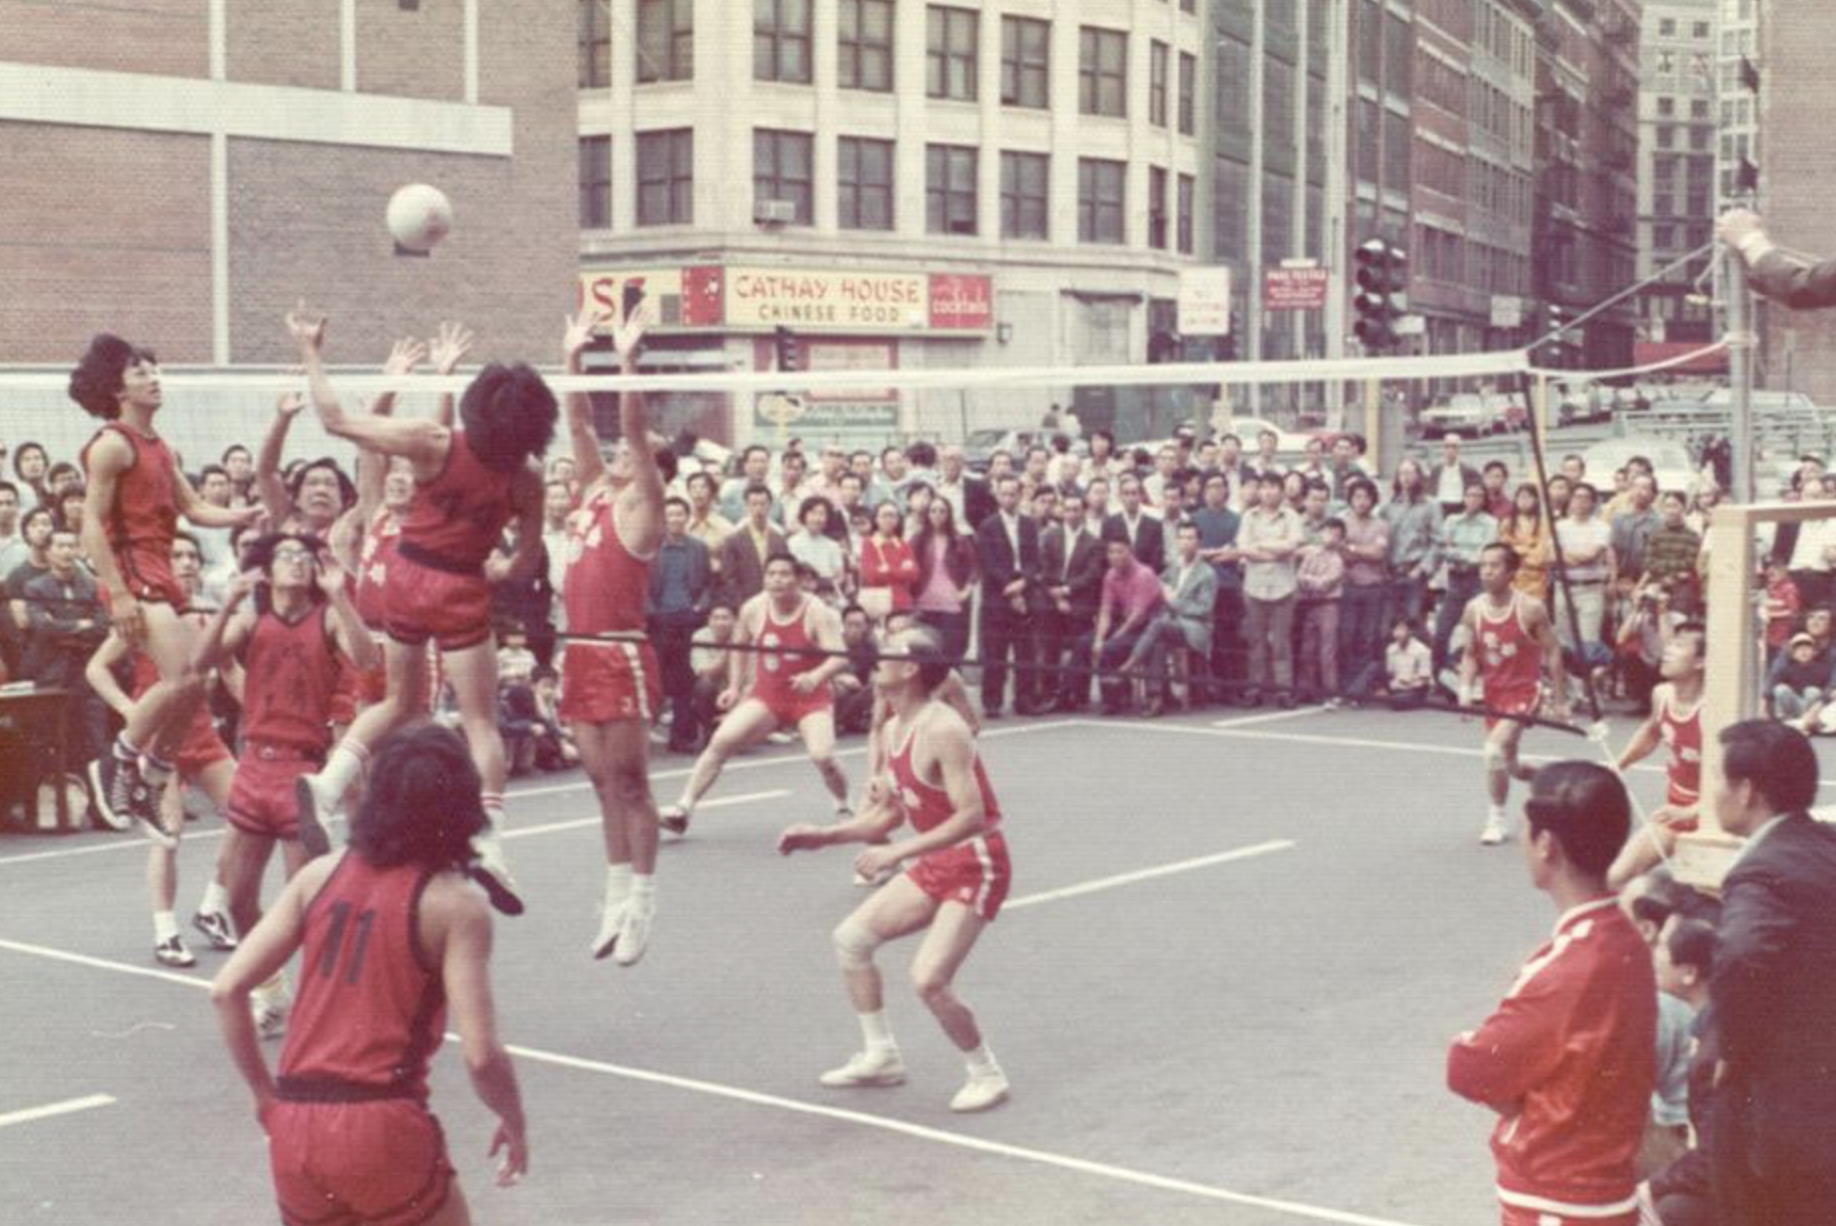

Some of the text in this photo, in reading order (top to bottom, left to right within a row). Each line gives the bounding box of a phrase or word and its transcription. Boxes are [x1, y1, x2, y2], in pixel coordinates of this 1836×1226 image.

[735, 274, 920, 304] CATHAY HOUSE
[758, 303, 900, 323] CHINESE FOOD
